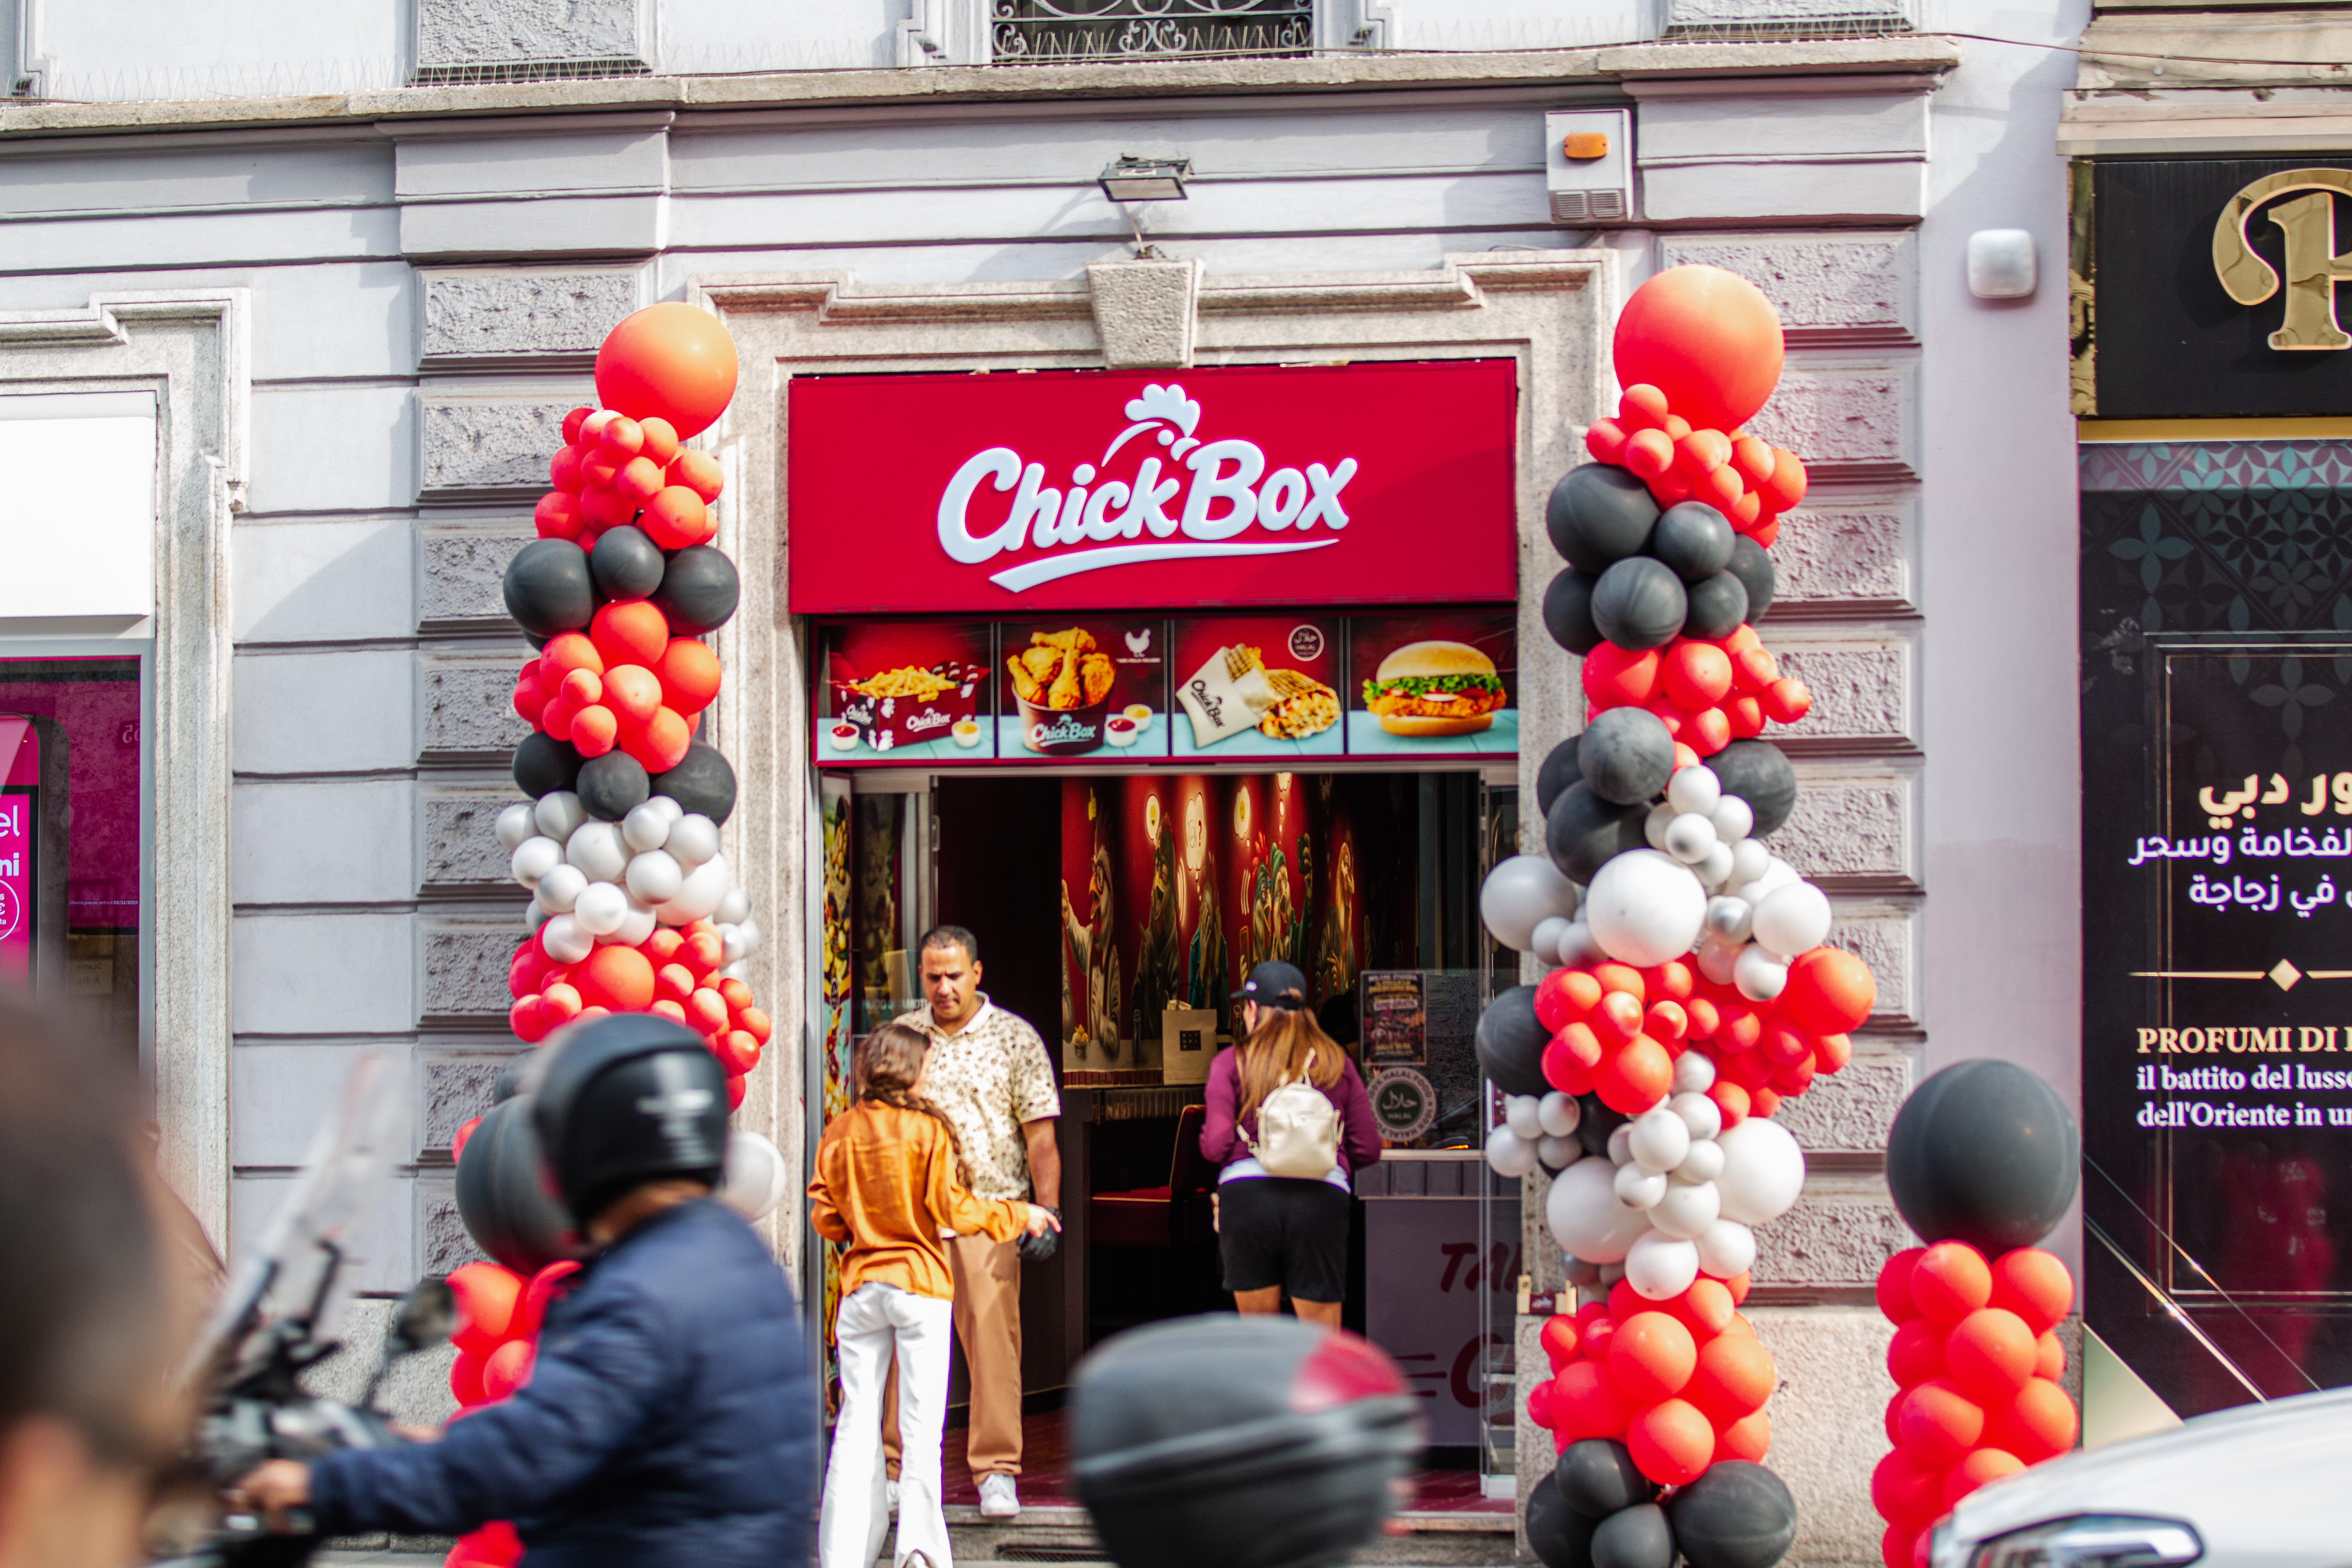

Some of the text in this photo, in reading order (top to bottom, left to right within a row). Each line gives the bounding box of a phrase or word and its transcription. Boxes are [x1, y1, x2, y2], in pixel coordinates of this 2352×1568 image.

[2199, 773, 2290, 830] دبي
[2128, 835, 2232, 866] وسحر
[2189, 873, 2279, 913] زجاجة
[2289, 874, 2336, 918] في
[2137, 1026, 2292, 1053] PROFUMI
[2298, 1026, 2338, 1052] DI
[2136, 1065, 2156, 1090] il
[2160, 1065, 2247, 1090] battito
[2251, 1063, 2292, 1090] del
[2136, 1101, 2291, 1127] dell'Oriente
[2295, 1101, 2323, 1127] in
